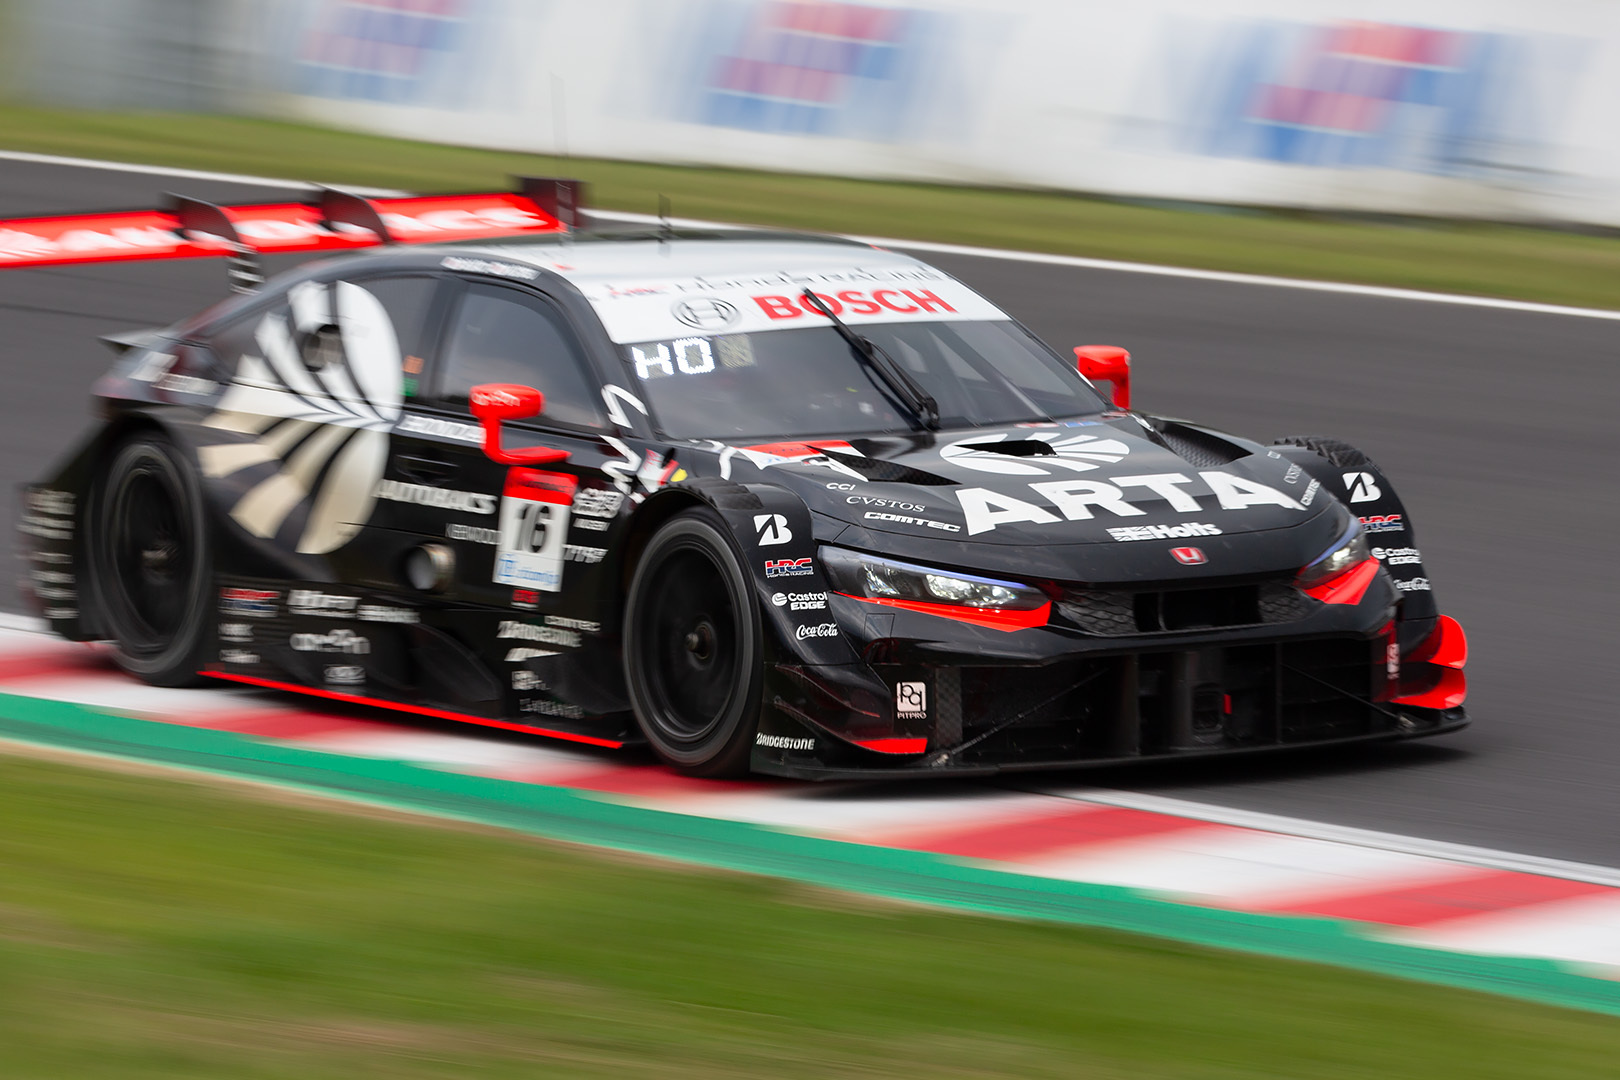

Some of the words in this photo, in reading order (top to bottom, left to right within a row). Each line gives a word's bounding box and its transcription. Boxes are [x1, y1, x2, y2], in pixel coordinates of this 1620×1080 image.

[749, 288, 959, 321] BOSCH
[825, 482, 856, 491] CCI
[846, 495, 926, 513] CVSTOS
[955, 470, 1308, 537] ARTA
[514, 504, 554, 553] 16
[864, 511, 961, 533] COMTEC
[1146, 522, 1223, 539] Holts
[765, 558, 813, 575] HRC
[787, 591, 828, 601] Castrol
[790, 601, 826, 611] EDGE
[796, 623, 838, 640] Coca-Cola
[755, 732, 815, 750] BRIDGESTONE
